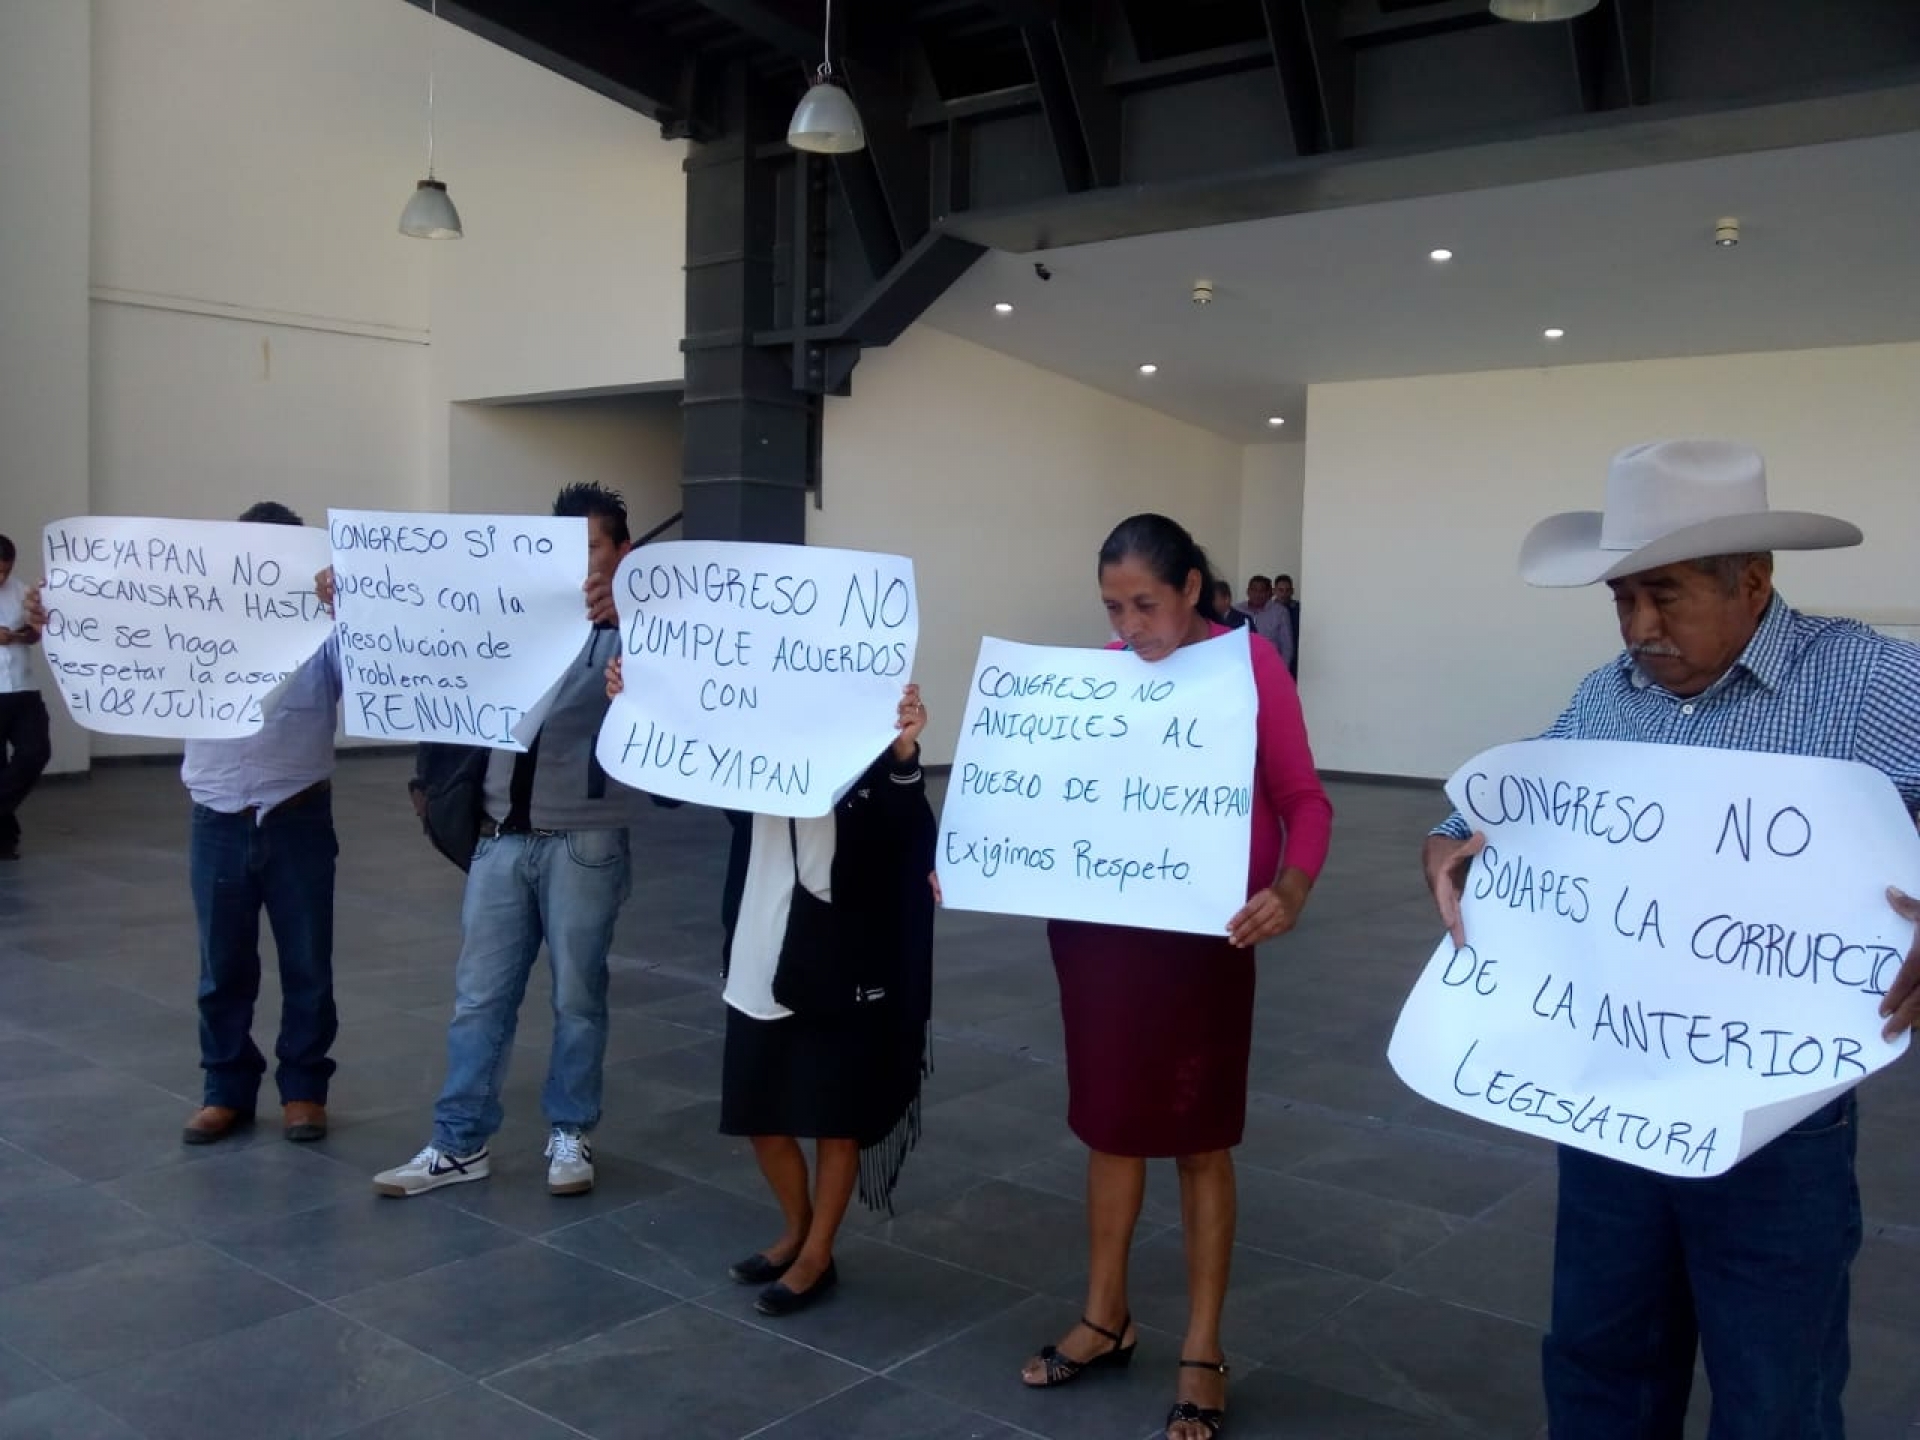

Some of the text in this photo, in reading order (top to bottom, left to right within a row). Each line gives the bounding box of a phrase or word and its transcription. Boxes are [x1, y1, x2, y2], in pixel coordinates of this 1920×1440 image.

[48, 530, 281, 586] HUEYAPAN NO
[331, 518, 448, 553] CONGRESO
[513, 534, 553, 555] no
[49, 567, 224, 612] DESCANSARA
[333, 564, 525, 615] puedes con la
[628, 563, 909, 629] CONGRESO NO
[46, 608, 239, 666] Que se haga
[477, 630, 512, 659] de
[628, 609, 906, 676] CUMPLE ACUERDOS
[189, 664, 214, 683] la
[345, 655, 468, 689] Problemas
[699, 678, 758, 711] CON
[978, 665, 1175, 702] CONGRESO NO
[356, 692, 526, 744] RENUNCI
[971, 706, 1204, 749] ANIQUILES AL
[621, 720, 811, 796] HUEYAPAN
[961, 763, 1250, 817] PUEBLO DE HUEYAPAN
[1465, 772, 1811, 862] CONGRESO NO
[946, 832, 1192, 893] Exigimos Respeto.
[1476, 845, 1590, 923] SOLAPES
[1614, 886, 1665, 948] LA
[1442, 944, 1867, 1078] DE LA ANTERIOR
[1454, 1039, 1718, 1172] LEGISLATURA
